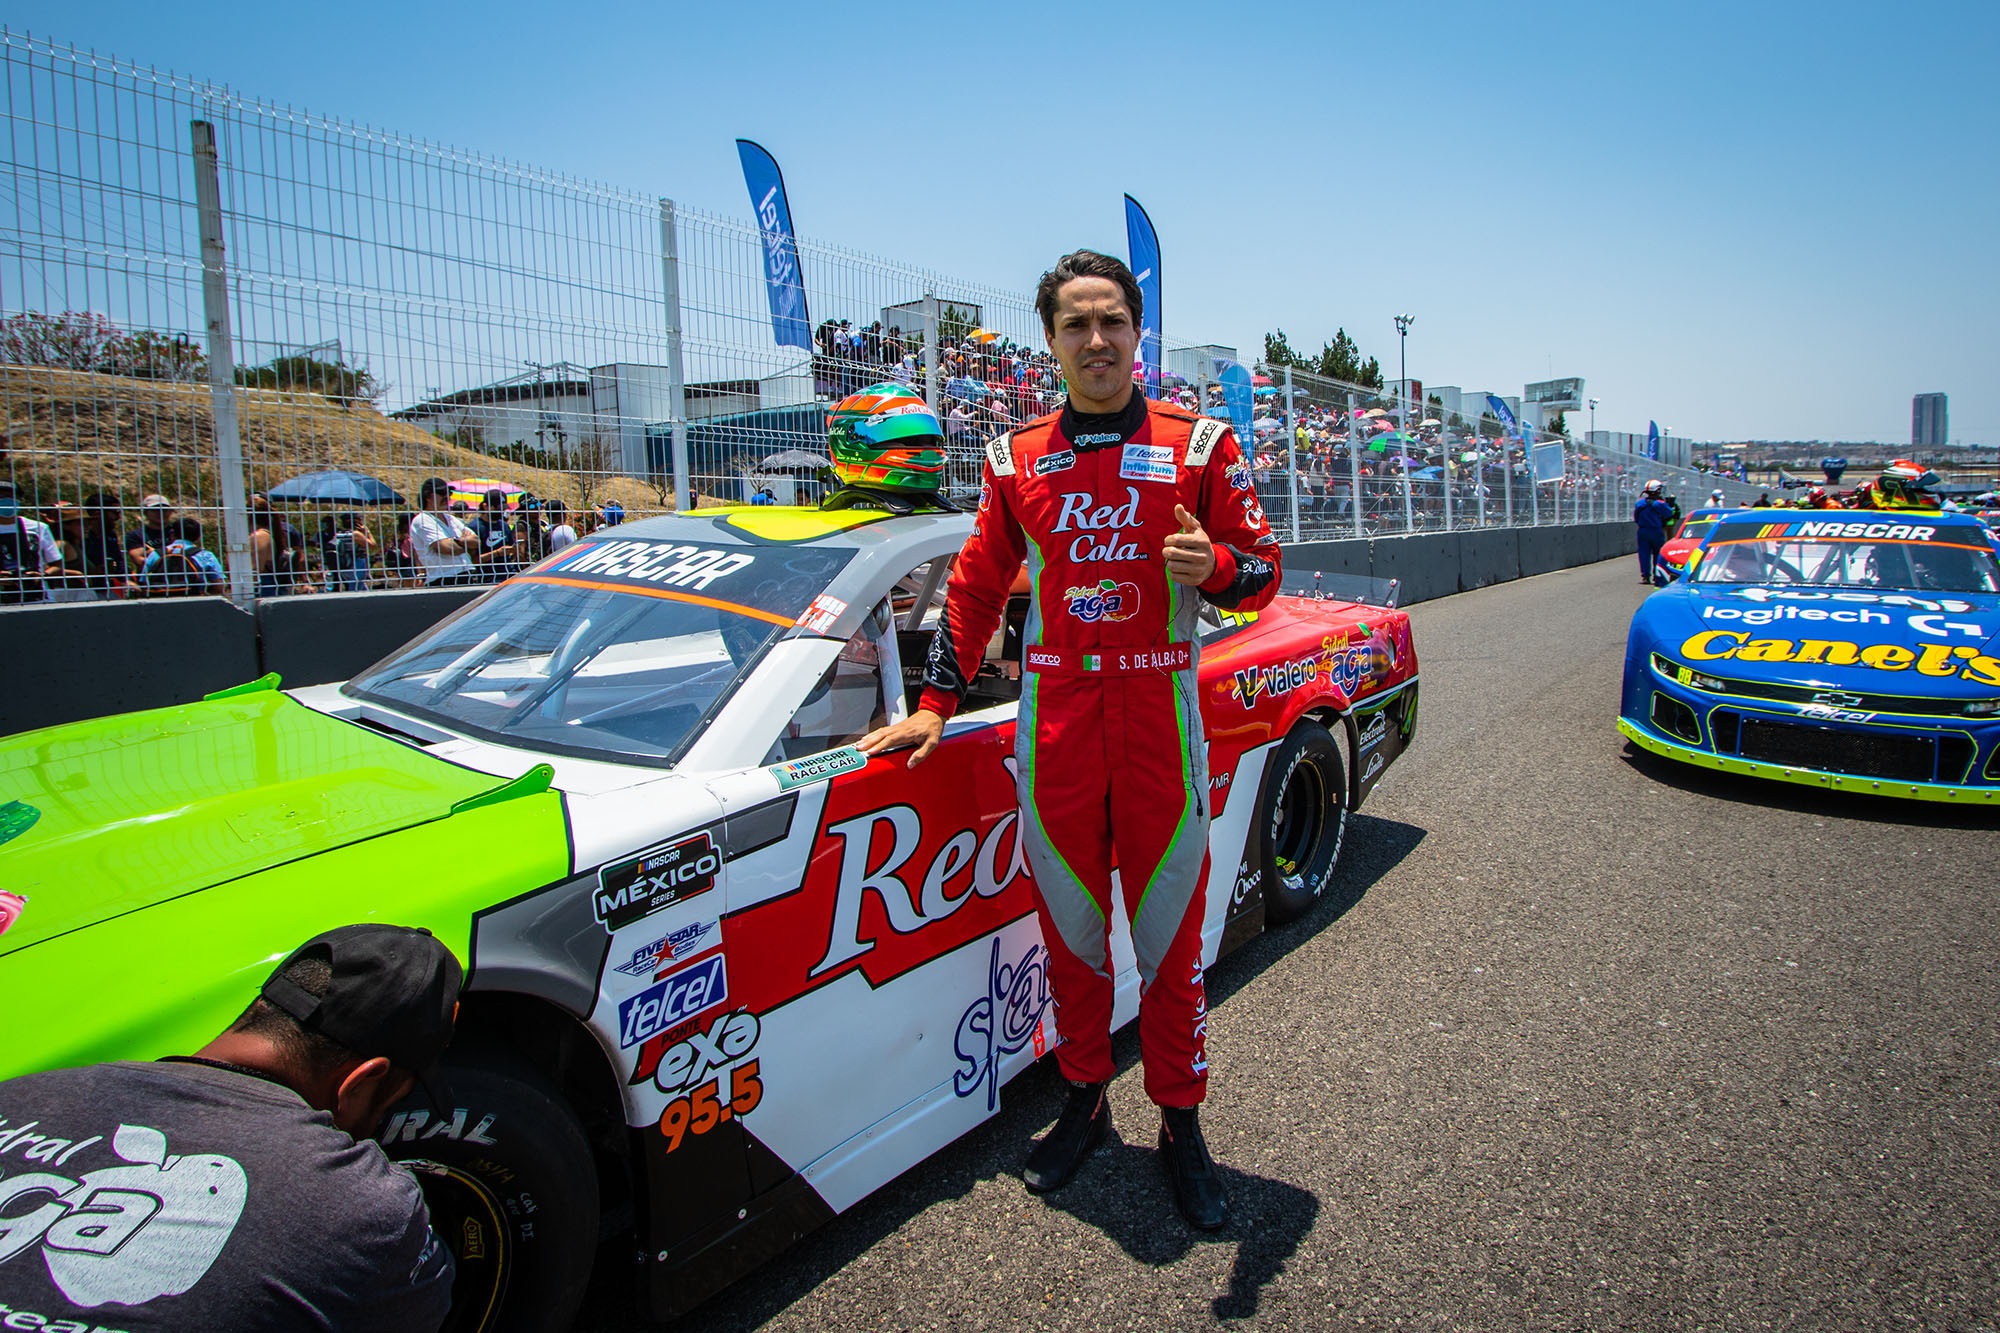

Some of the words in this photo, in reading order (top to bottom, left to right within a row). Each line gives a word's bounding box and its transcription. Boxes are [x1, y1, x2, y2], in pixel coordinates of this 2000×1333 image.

[1090, 433, 1121, 443] Valero
[1194, 422, 1218, 454] sparco
[1036, 455, 1073, 471] MÉXICO
[1136, 448, 1172, 459] telcel
[1050, 486, 1144, 534] Red
[1799, 521, 1936, 541] NASCAR
[1068, 532, 1140, 563] Cola
[558, 541, 756, 591] NASCAR
[1063, 584, 1101, 601] Sidral
[1069, 594, 1122, 623] aga
[1702, 605, 1890, 626] logitech
[1029, 652, 1061, 665] sparco
[1321, 630, 1350, 661] Sidral
[1119, 654, 1130, 670] S.
[1134, 653, 1148, 669] DE
[1330, 646, 1373, 698] aga
[1264, 657, 1316, 698] Valero
[789, 765, 827, 781] RACE
[829, 756, 857, 770] CAR
[799, 750, 849, 768] NASCAR
[648, 849, 681, 871] NASCAR
[806, 756, 1031, 982] Red
[1215, 772, 1230, 790] MR
[1239, 860, 1248, 876] Mi
[600, 854, 717, 915] MÉXICO
[650, 889, 676, 907] SERIES
[1233, 869, 1262, 905] Choco
[632, 942, 665, 965] FIVE
[668, 923, 701, 947] STAR
[622, 959, 721, 1047] telcel
[661, 1018, 702, 1047] PONTE
[659, 1060, 762, 1154] 95.5
[466, 1224, 478, 1253] AERO
